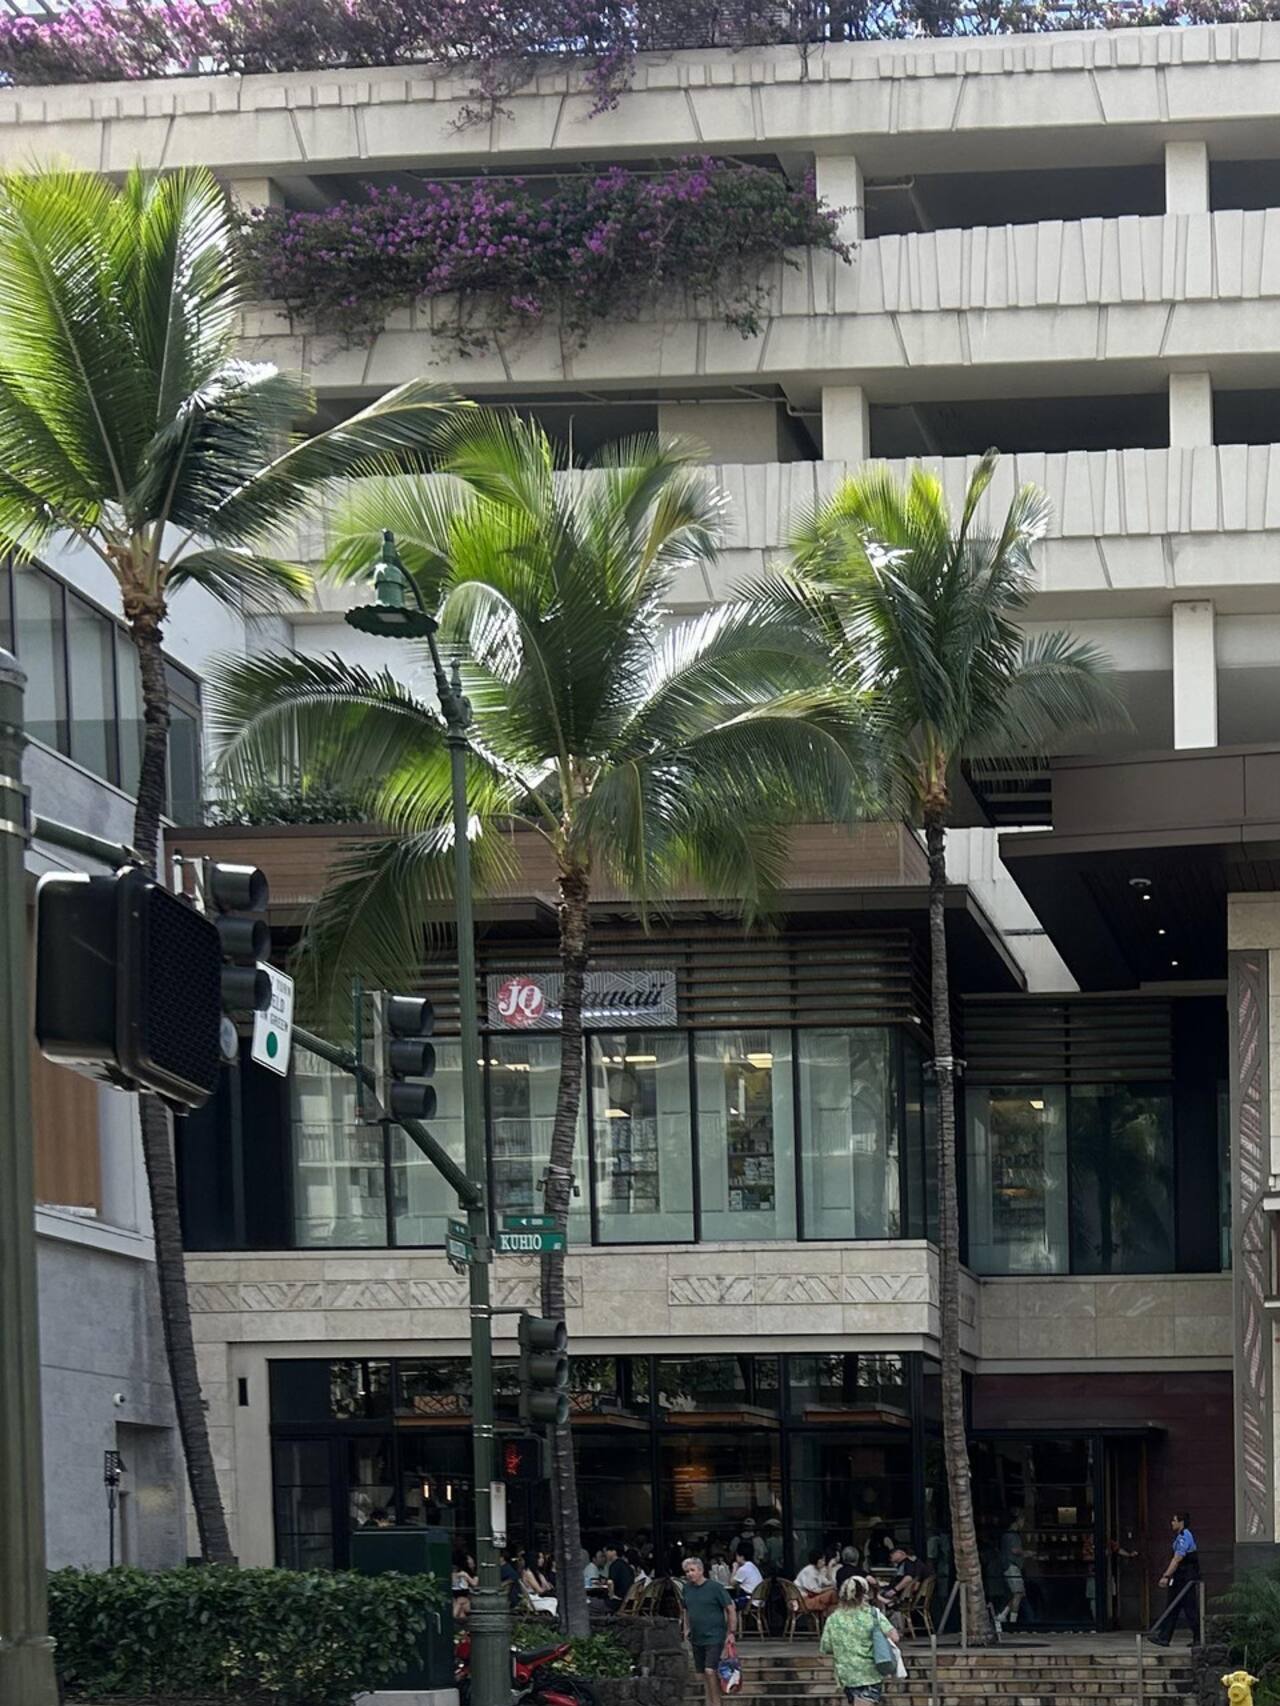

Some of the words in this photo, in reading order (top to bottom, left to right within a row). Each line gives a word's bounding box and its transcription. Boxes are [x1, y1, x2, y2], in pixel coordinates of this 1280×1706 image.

[498, 982, 543, 1018] JQ
[550, 982, 666, 1008] awaii
[500, 1234, 542, 1250] KUHIO
